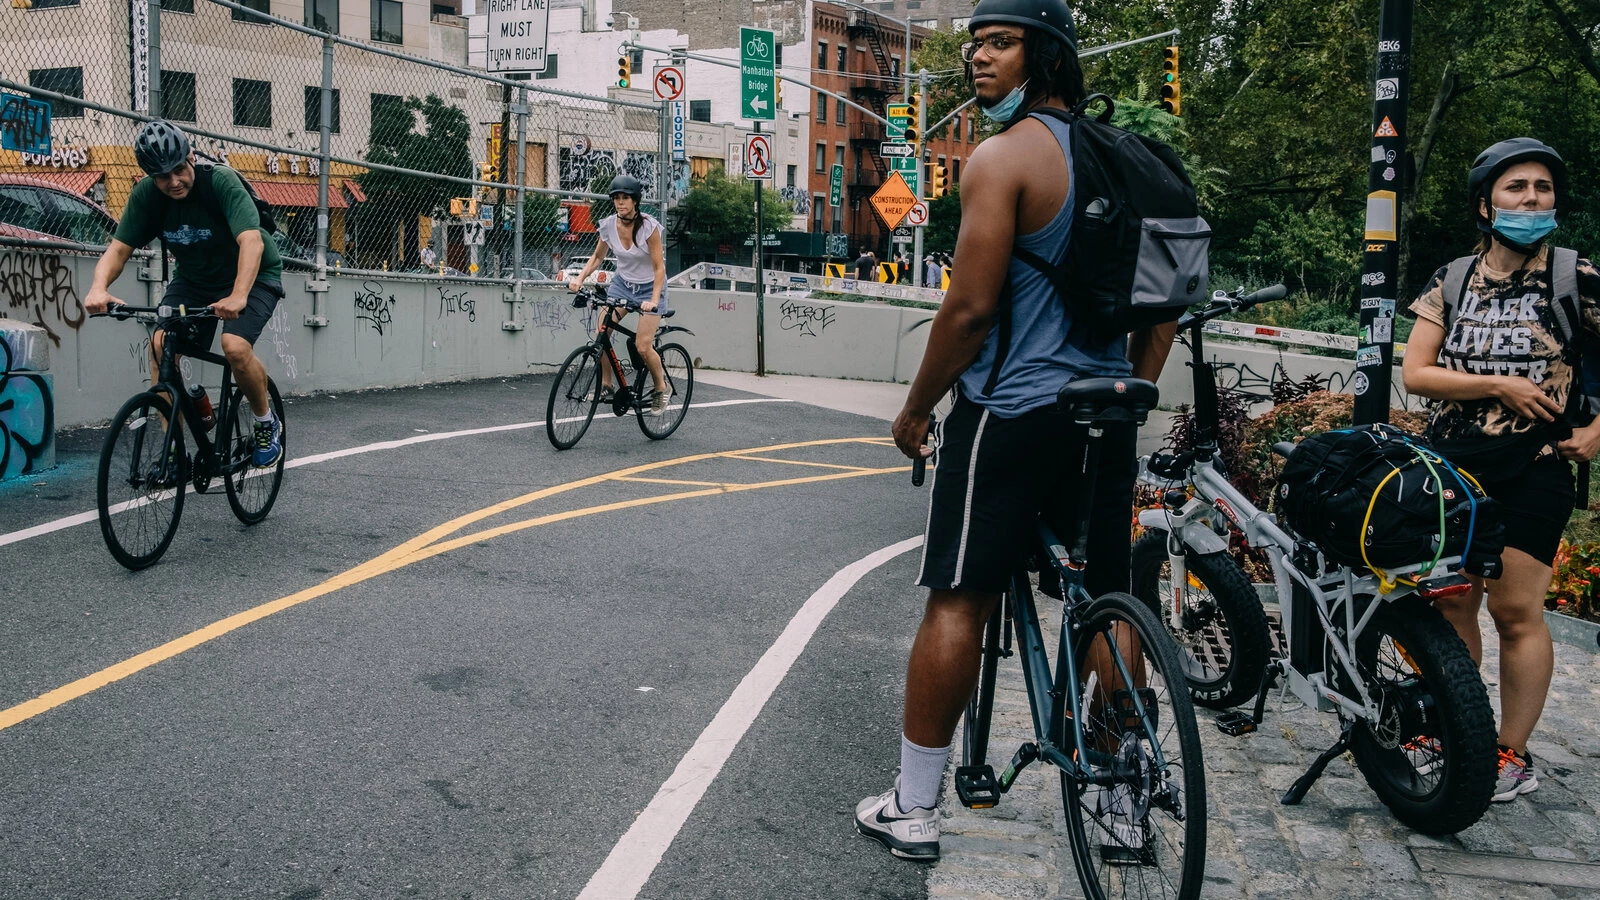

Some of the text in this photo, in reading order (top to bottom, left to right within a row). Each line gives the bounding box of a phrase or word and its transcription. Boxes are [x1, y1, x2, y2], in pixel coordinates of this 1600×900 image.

[491, 0, 546, 12] RIGHT LANE
[500, 21, 532, 38] MUST
[1379, 41, 1400, 50] REK6
[490, 47, 543, 61] TURN RIGHT
[742, 65, 774, 77] Manhattan
[748, 80, 768, 93] Bridge
[674, 102, 683, 147] LIQUOR
[874, 196, 914, 205] CONSTRUCTION
[884, 207, 903, 215] AHEAD
[1446, 322, 1532, 357] LIVES
[909, 820, 937, 837] AIR
